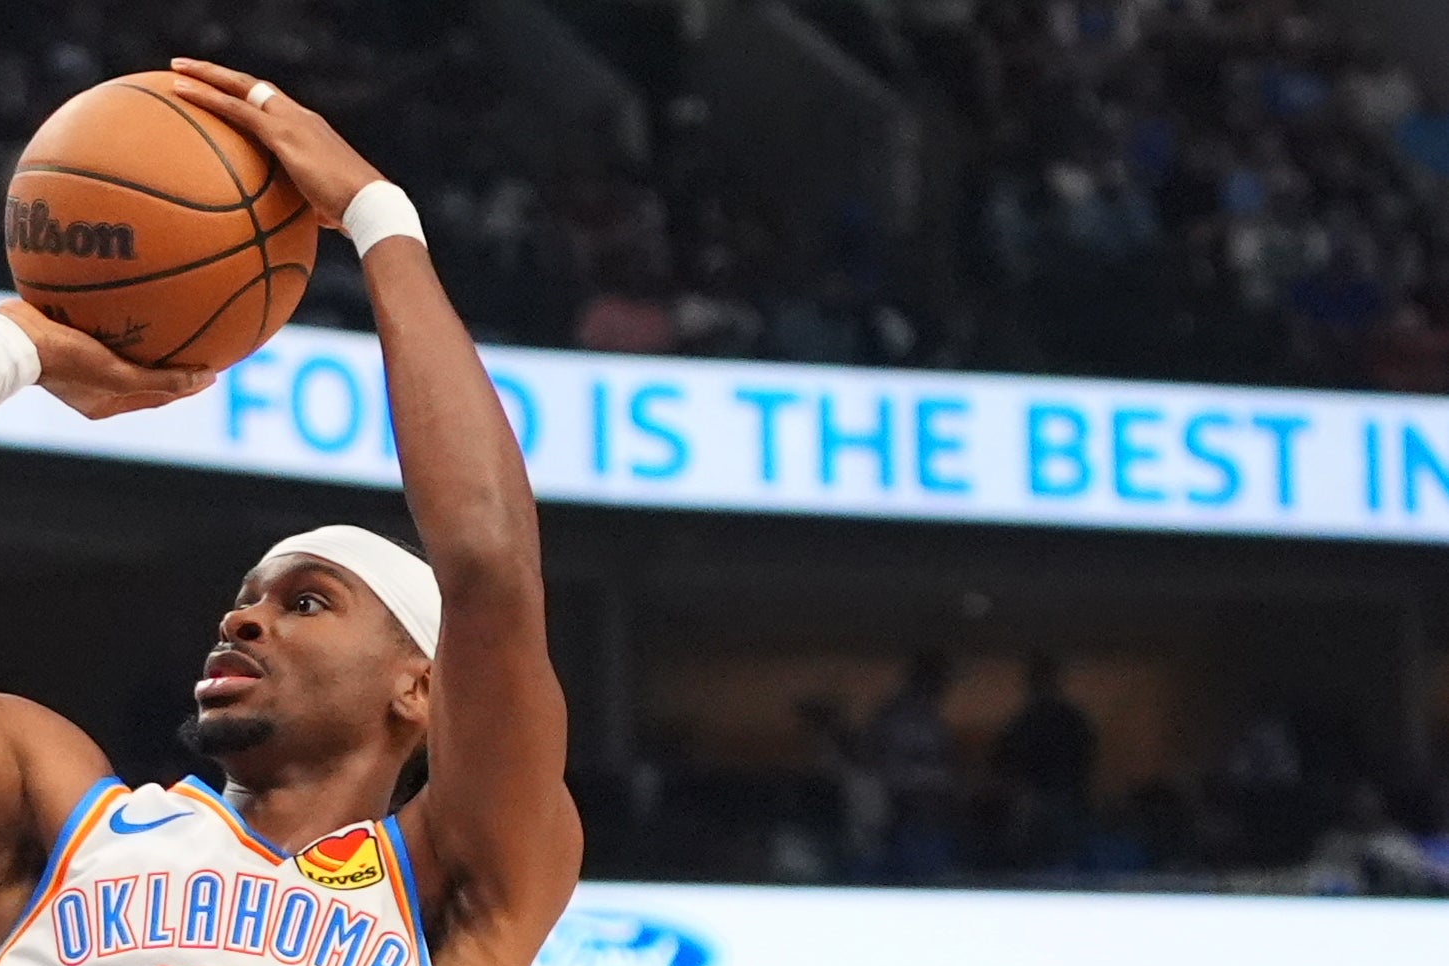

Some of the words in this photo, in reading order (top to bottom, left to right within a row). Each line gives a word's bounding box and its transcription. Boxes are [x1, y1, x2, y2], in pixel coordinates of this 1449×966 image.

[224, 350, 544, 464] FOD
[591, 381, 690, 480] IS
[733, 387, 973, 492] THE
[1026, 402, 1311, 507] BEST
